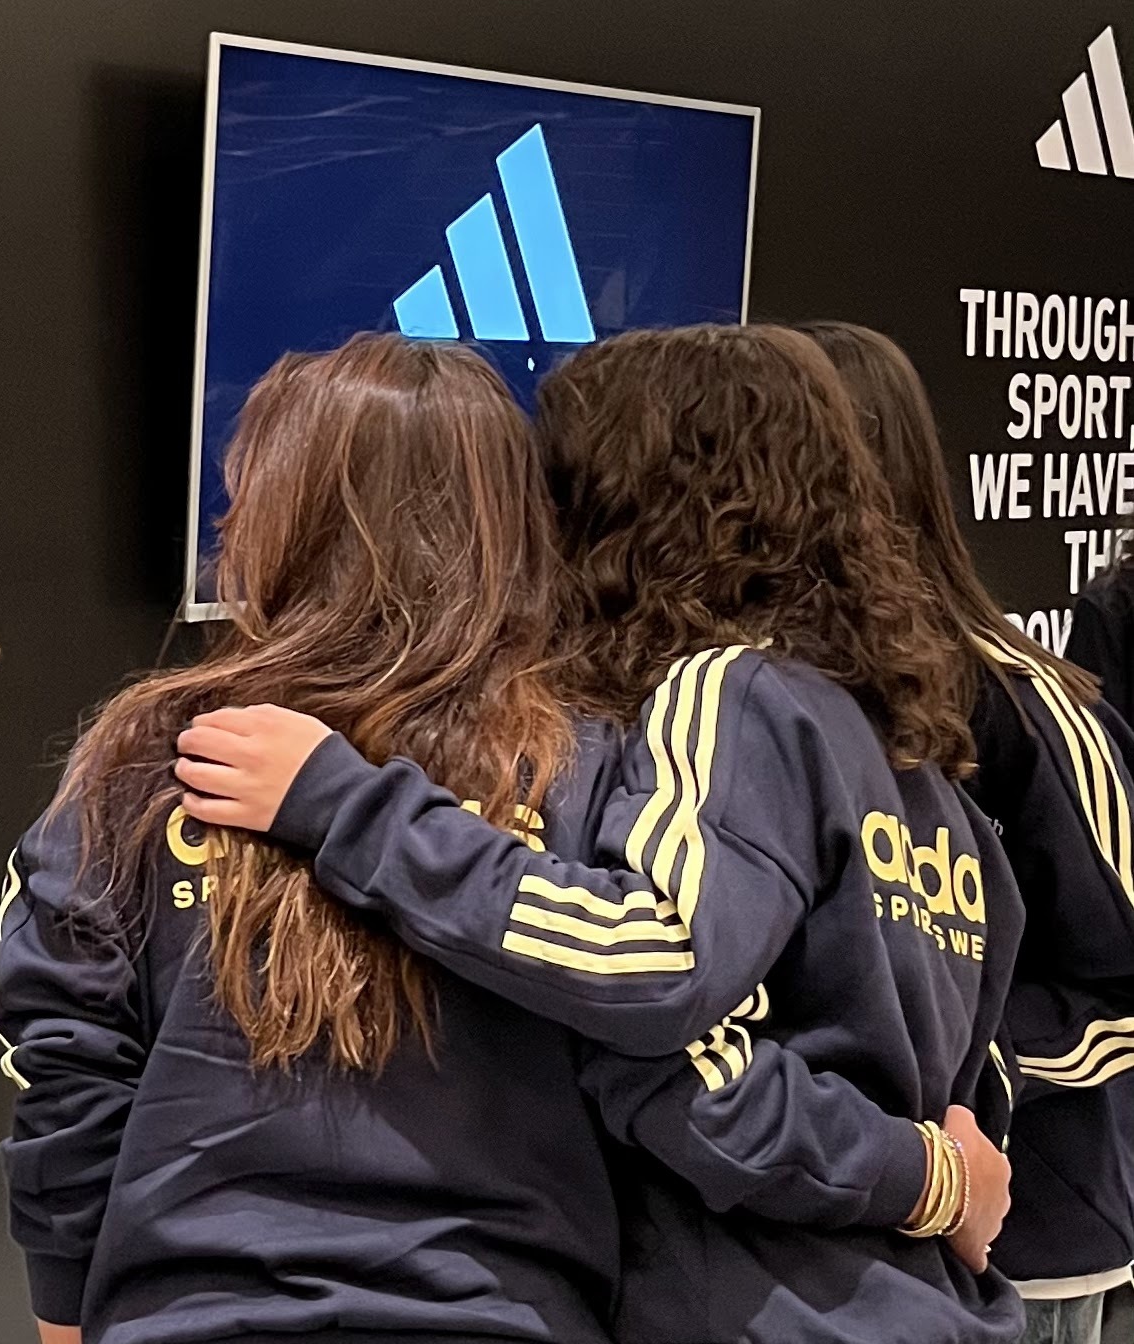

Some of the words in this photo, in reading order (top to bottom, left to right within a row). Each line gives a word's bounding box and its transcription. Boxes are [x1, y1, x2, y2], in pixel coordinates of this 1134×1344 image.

[960, 288, 1134, 362] THROUGH
[969, 453, 1033, 520] WE
[1043, 452, 1134, 518] HAVE
